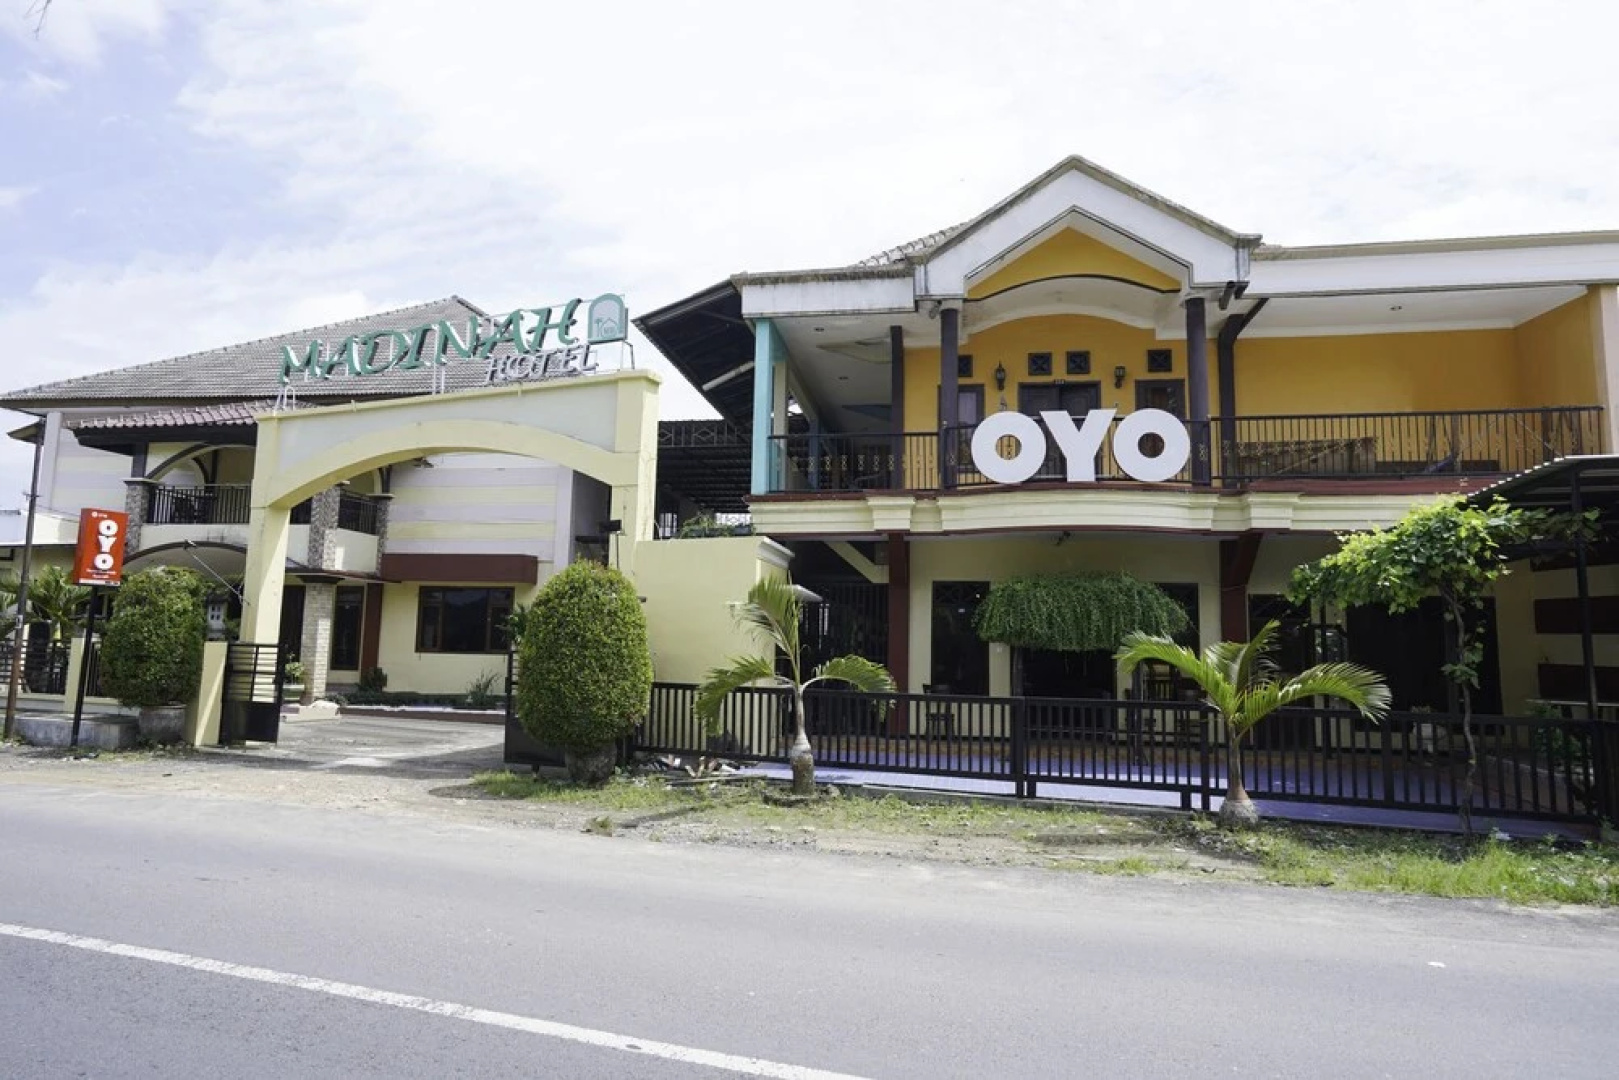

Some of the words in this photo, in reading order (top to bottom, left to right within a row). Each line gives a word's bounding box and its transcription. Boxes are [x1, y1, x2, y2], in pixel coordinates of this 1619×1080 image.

[278, 297, 581, 384] MADINAH
[485, 344, 599, 383] HOTEL
[971, 408, 1190, 484] OYO
[94, 520, 118, 570] OYO
